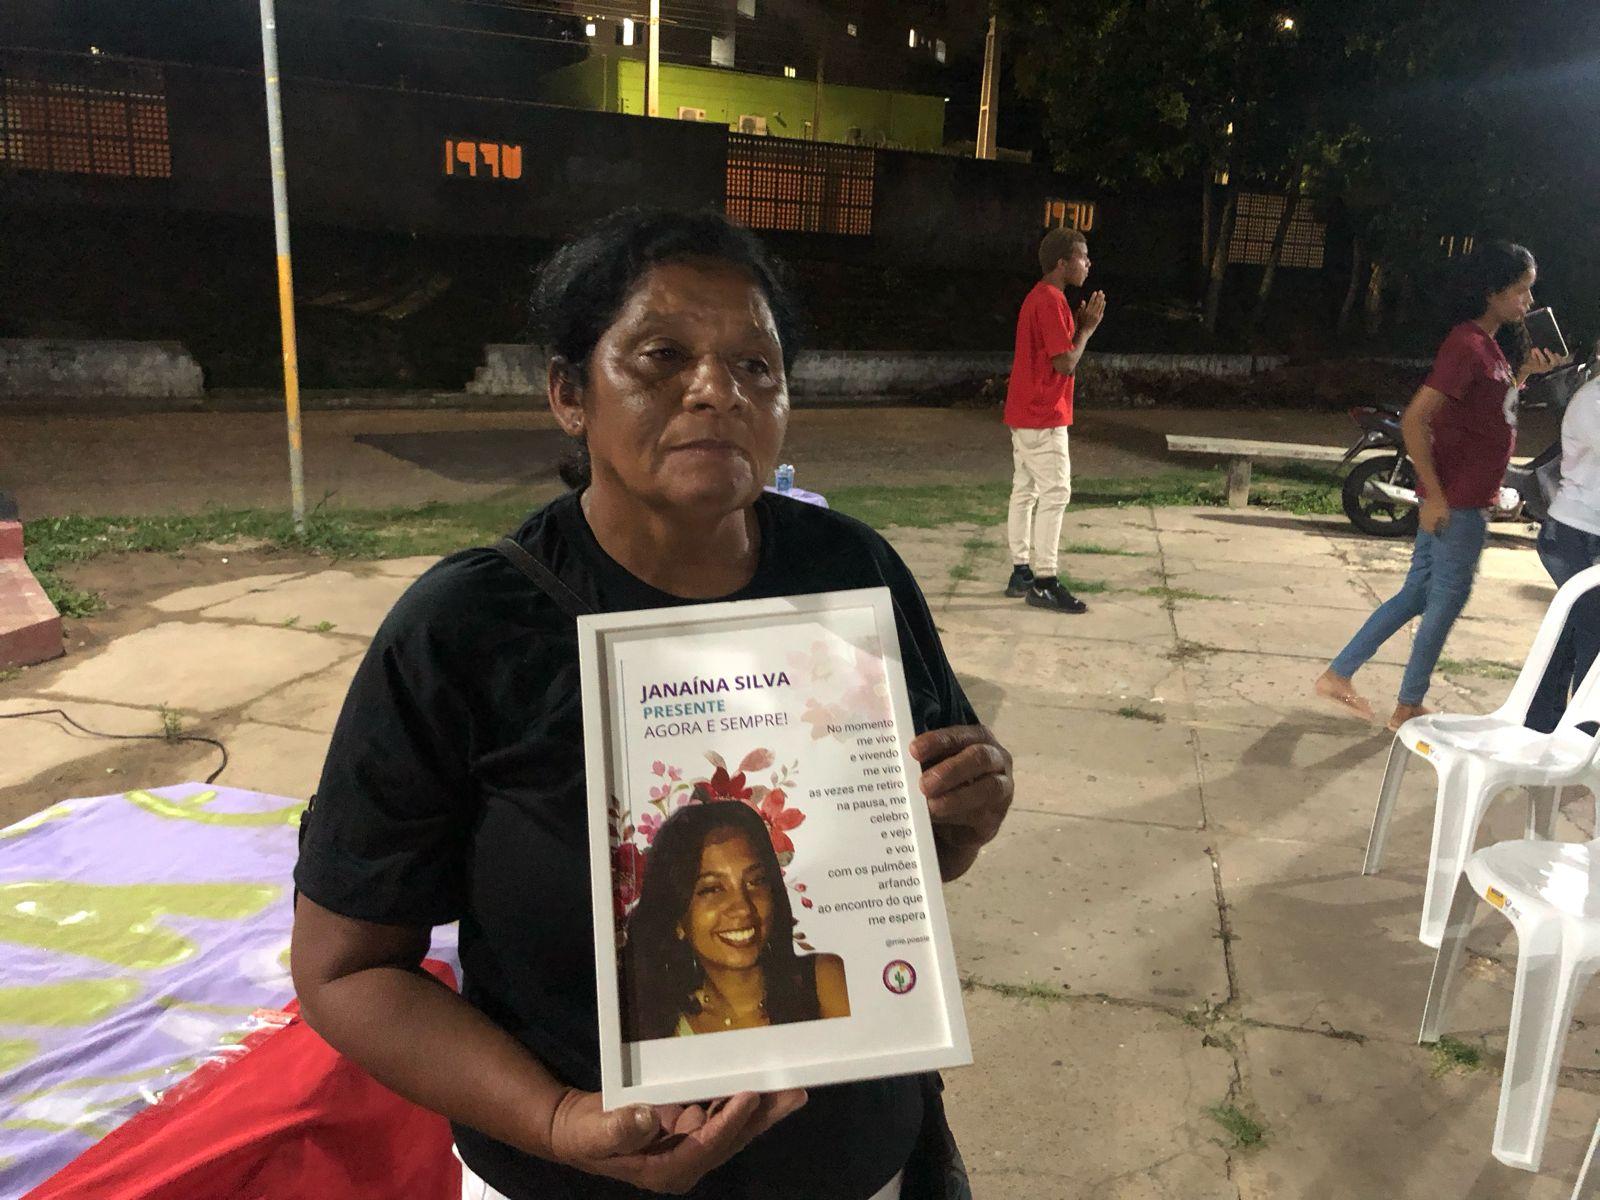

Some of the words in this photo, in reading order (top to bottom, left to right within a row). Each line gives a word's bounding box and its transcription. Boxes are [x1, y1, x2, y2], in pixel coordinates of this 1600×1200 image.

[640, 676, 729, 704] JANAÍNA
[735, 671, 791, 691] SILVA
[643, 699, 726, 720] PRESENTE
[644, 720, 703, 739] AGORA
[707, 719, 716, 733] E
[720, 712, 788, 732] SEMPRE!
[827, 724, 842, 734] No
[844, 719, 894, 733] momento
[856, 737, 873, 746] me
[875, 733, 897, 744] vivo
[850, 754, 857, 762] e
[859, 748, 899, 760] vivendo
[863, 767, 880, 776] me
[882, 764, 902, 774] viro
[809, 789, 822, 798] as
[824, 784, 855, 796] vezes
[857, 783, 874, 793] me
[876, 779, 904, 790] retiro
[836, 801, 851, 811] na
[853, 798, 888, 812] pausa,
[890, 796, 907, 806] me
[870, 811, 910, 824] celebro
[881, 830, 888, 839] e
[889, 827, 912, 839] vejo
[886, 846, 893, 855] e
[894, 844, 915, 854] vou
[828, 868, 853, 879] com
[855, 865, 869, 875] os
[871, 859, 918, 876] pulmões
[878, 876, 921, 891] arfando
[818, 904, 832, 915] ao
[834, 897, 884, 912] encontro
[886, 894, 900, 907] do
[902, 893, 924, 907] que
[868, 915, 886, 926] me
[888, 910, 926, 924] espera
